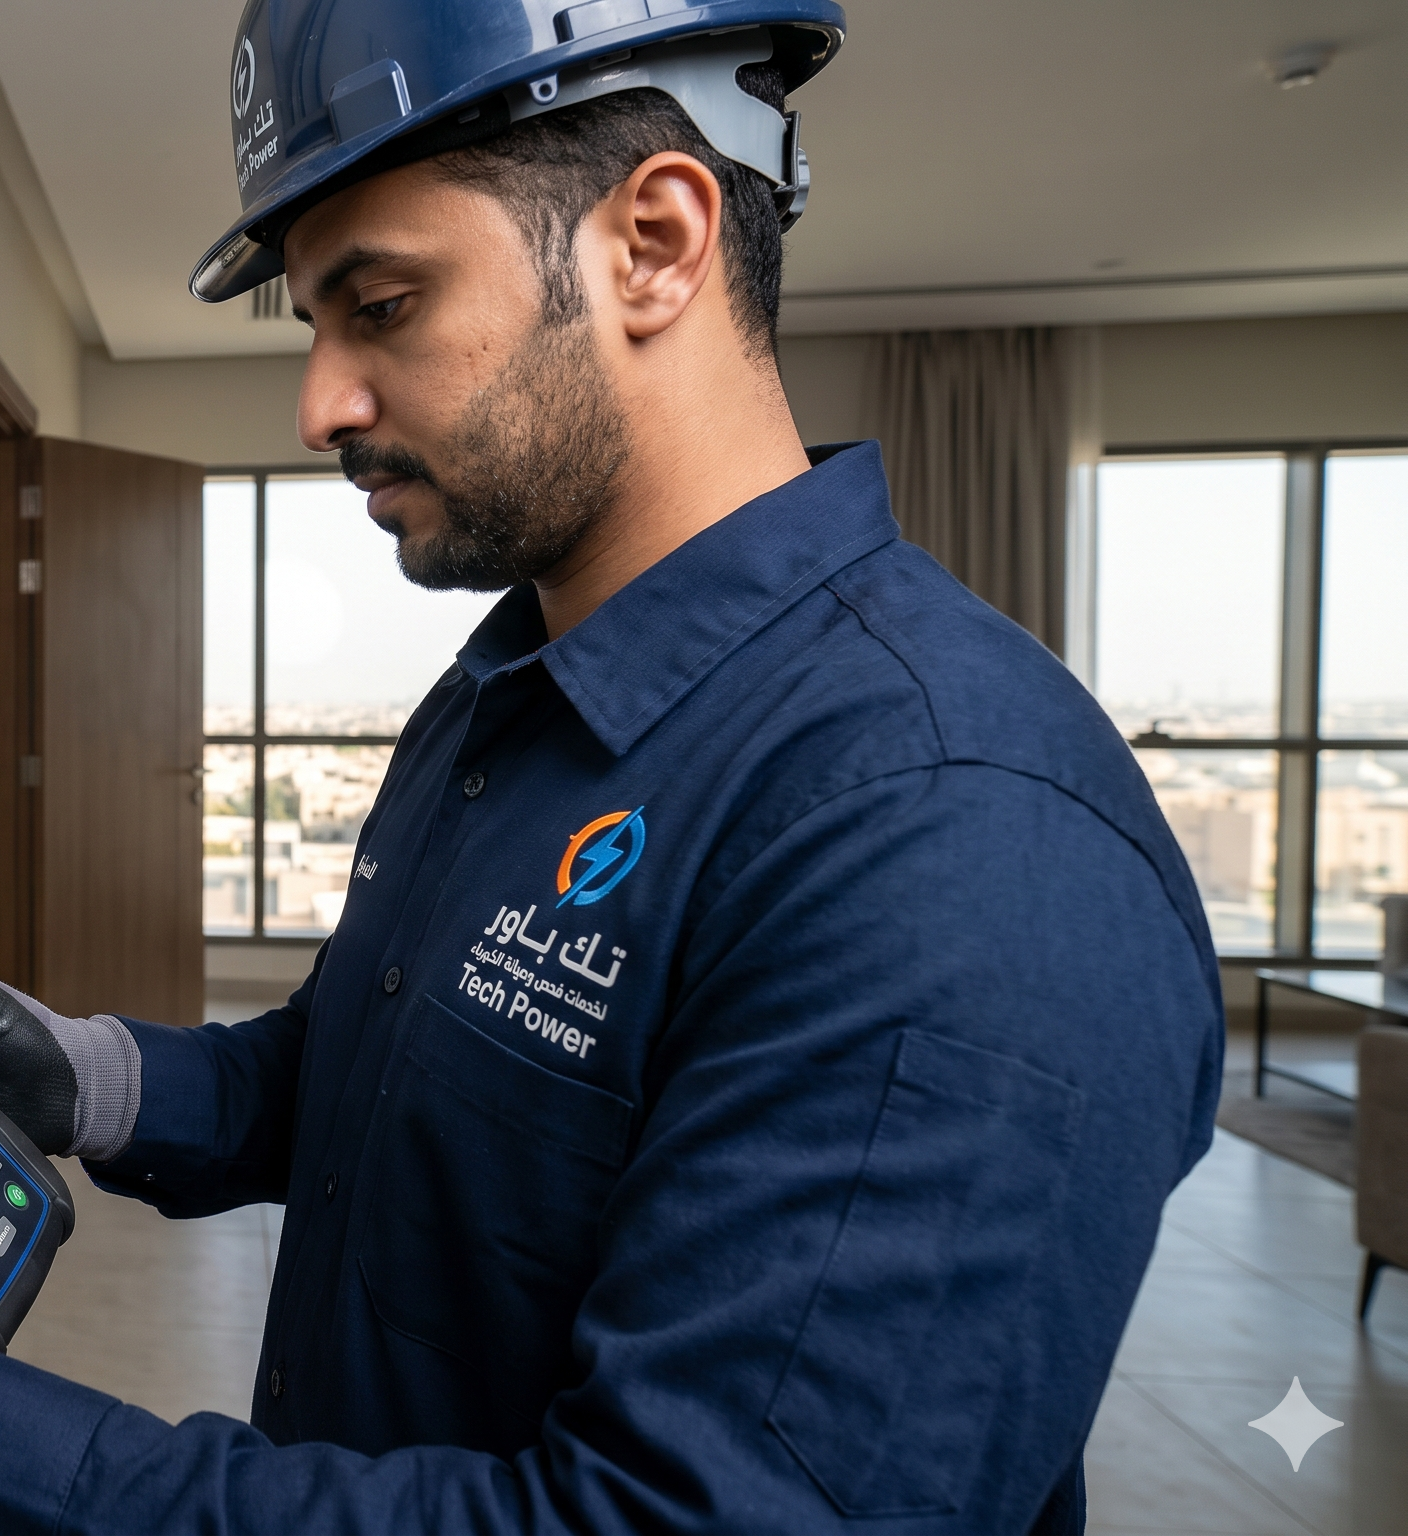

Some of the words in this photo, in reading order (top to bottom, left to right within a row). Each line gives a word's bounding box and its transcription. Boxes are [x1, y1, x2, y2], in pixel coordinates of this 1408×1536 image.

[248, 135, 279, 176] Power
[484, 904, 558, 964] باور
[559, 933, 627, 988] تك
[458, 961, 506, 1012] Tech
[507, 990, 597, 1060] Power
[534, 979, 564, 999] فحص
[564, 988, 608, 1021] لخدمات
